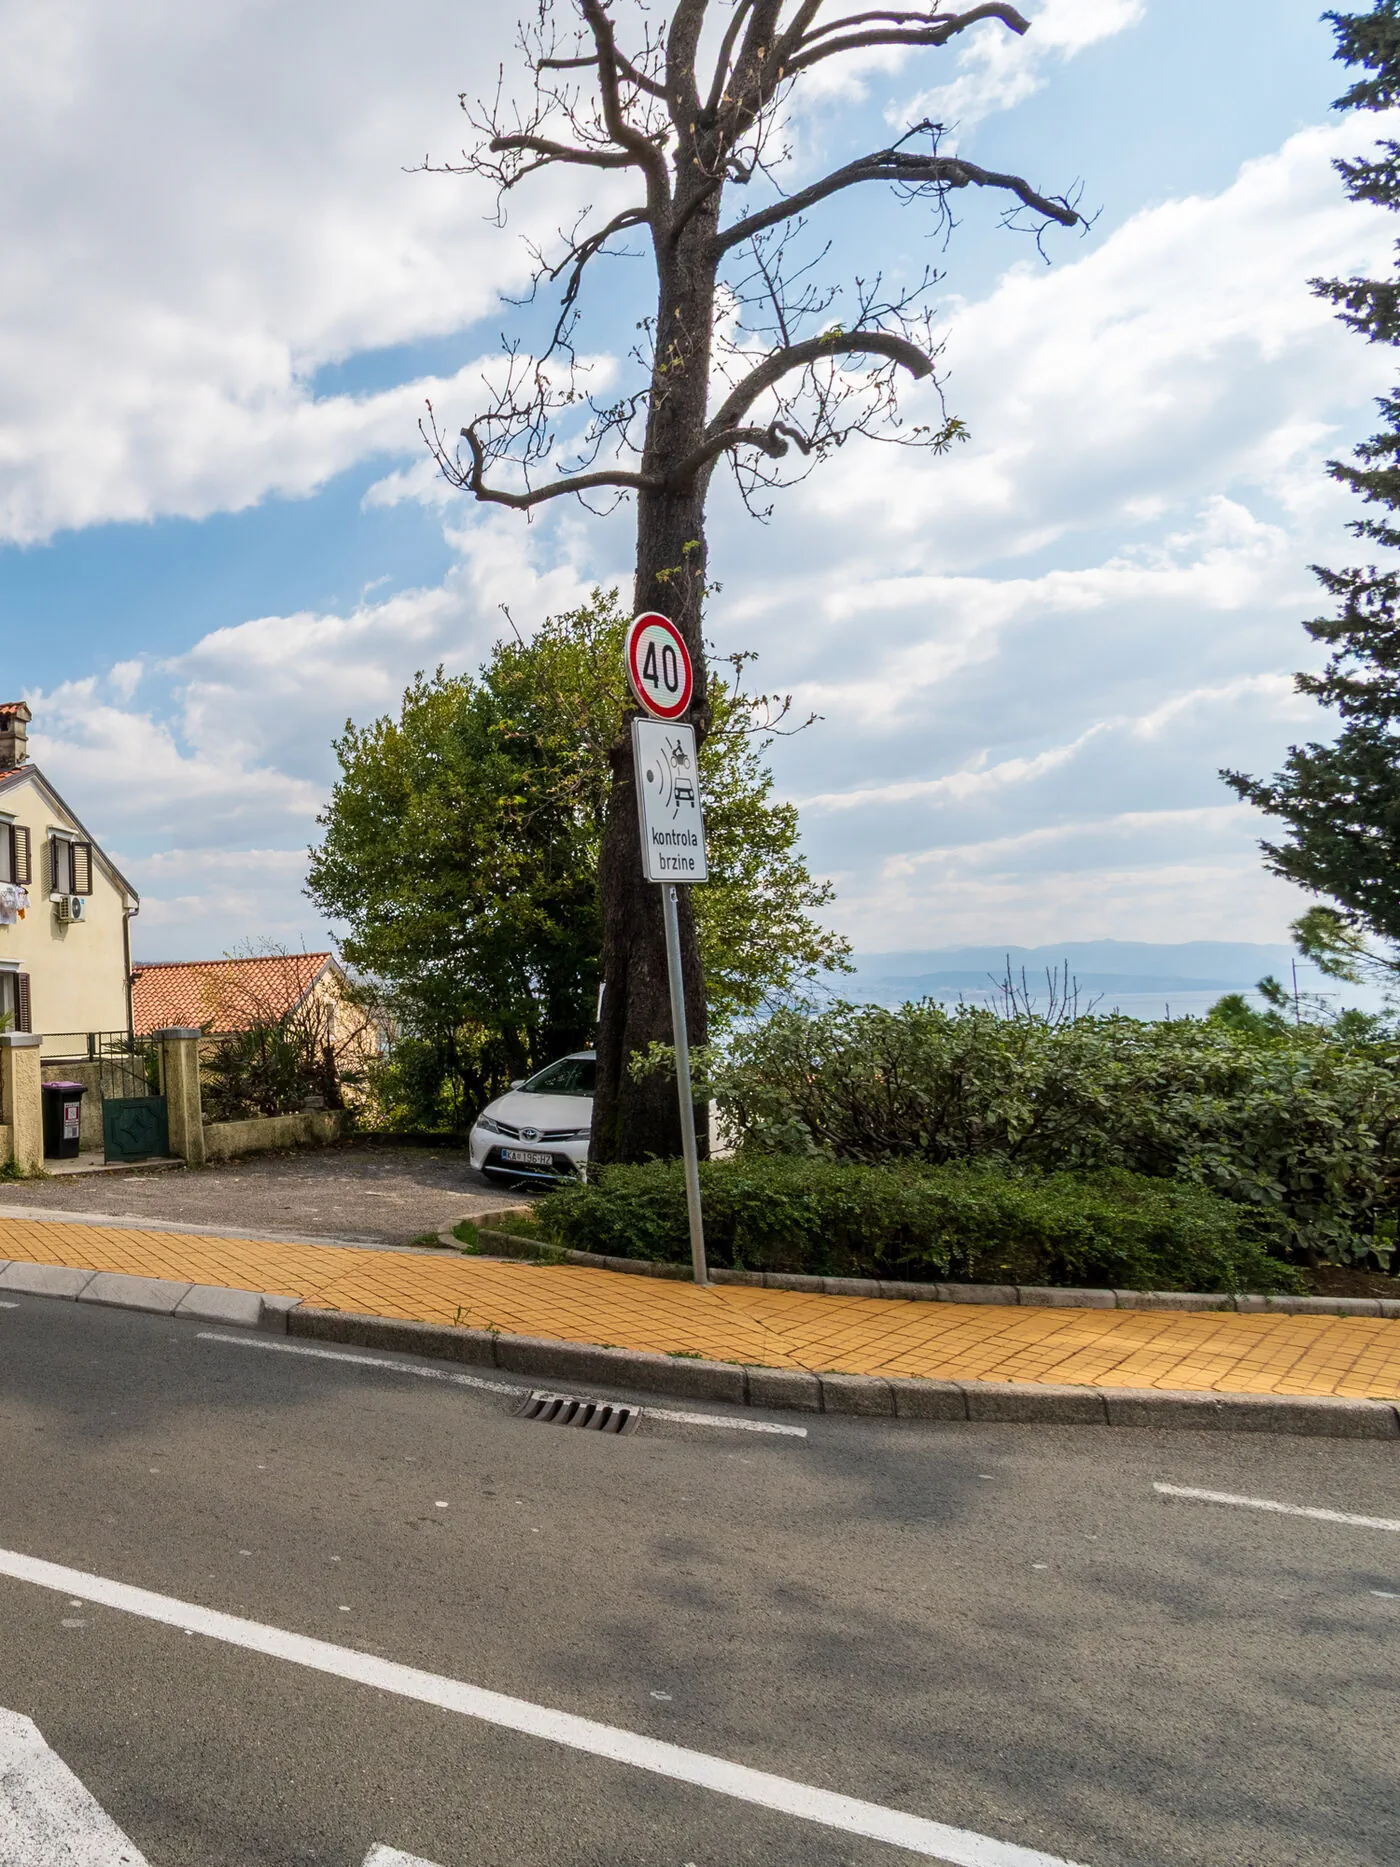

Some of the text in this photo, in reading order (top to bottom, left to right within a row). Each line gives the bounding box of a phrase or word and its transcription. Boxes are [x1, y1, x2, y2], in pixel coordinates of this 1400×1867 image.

[643, 641, 678, 693] 40
[652, 827, 698, 847] kontrola
[659, 852, 695, 871] brzine
